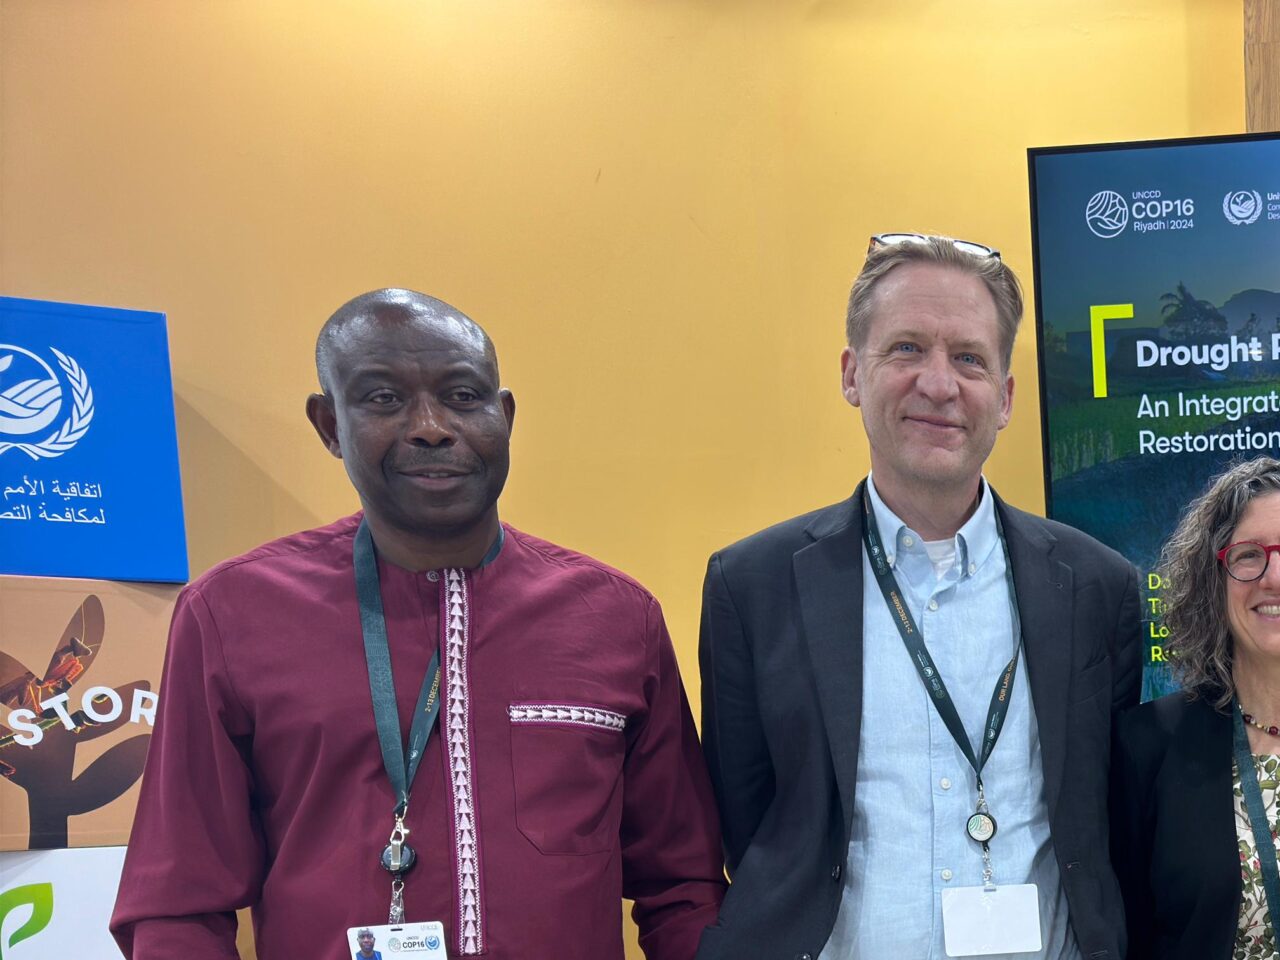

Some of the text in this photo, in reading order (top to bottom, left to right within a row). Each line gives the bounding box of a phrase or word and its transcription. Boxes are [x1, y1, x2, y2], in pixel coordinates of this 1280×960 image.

[1132, 190, 1161, 199] UNCCD
[1131, 199, 1195, 219] COP16
[1133, 219, 1194, 233] Riyadh 2024
[1136, 335, 1262, 371] Drought
[1136, 394, 1169, 419] An
[4, 475, 102, 501] اتفاقية الأمم
[38, 502, 106, 524] لمكافحة
